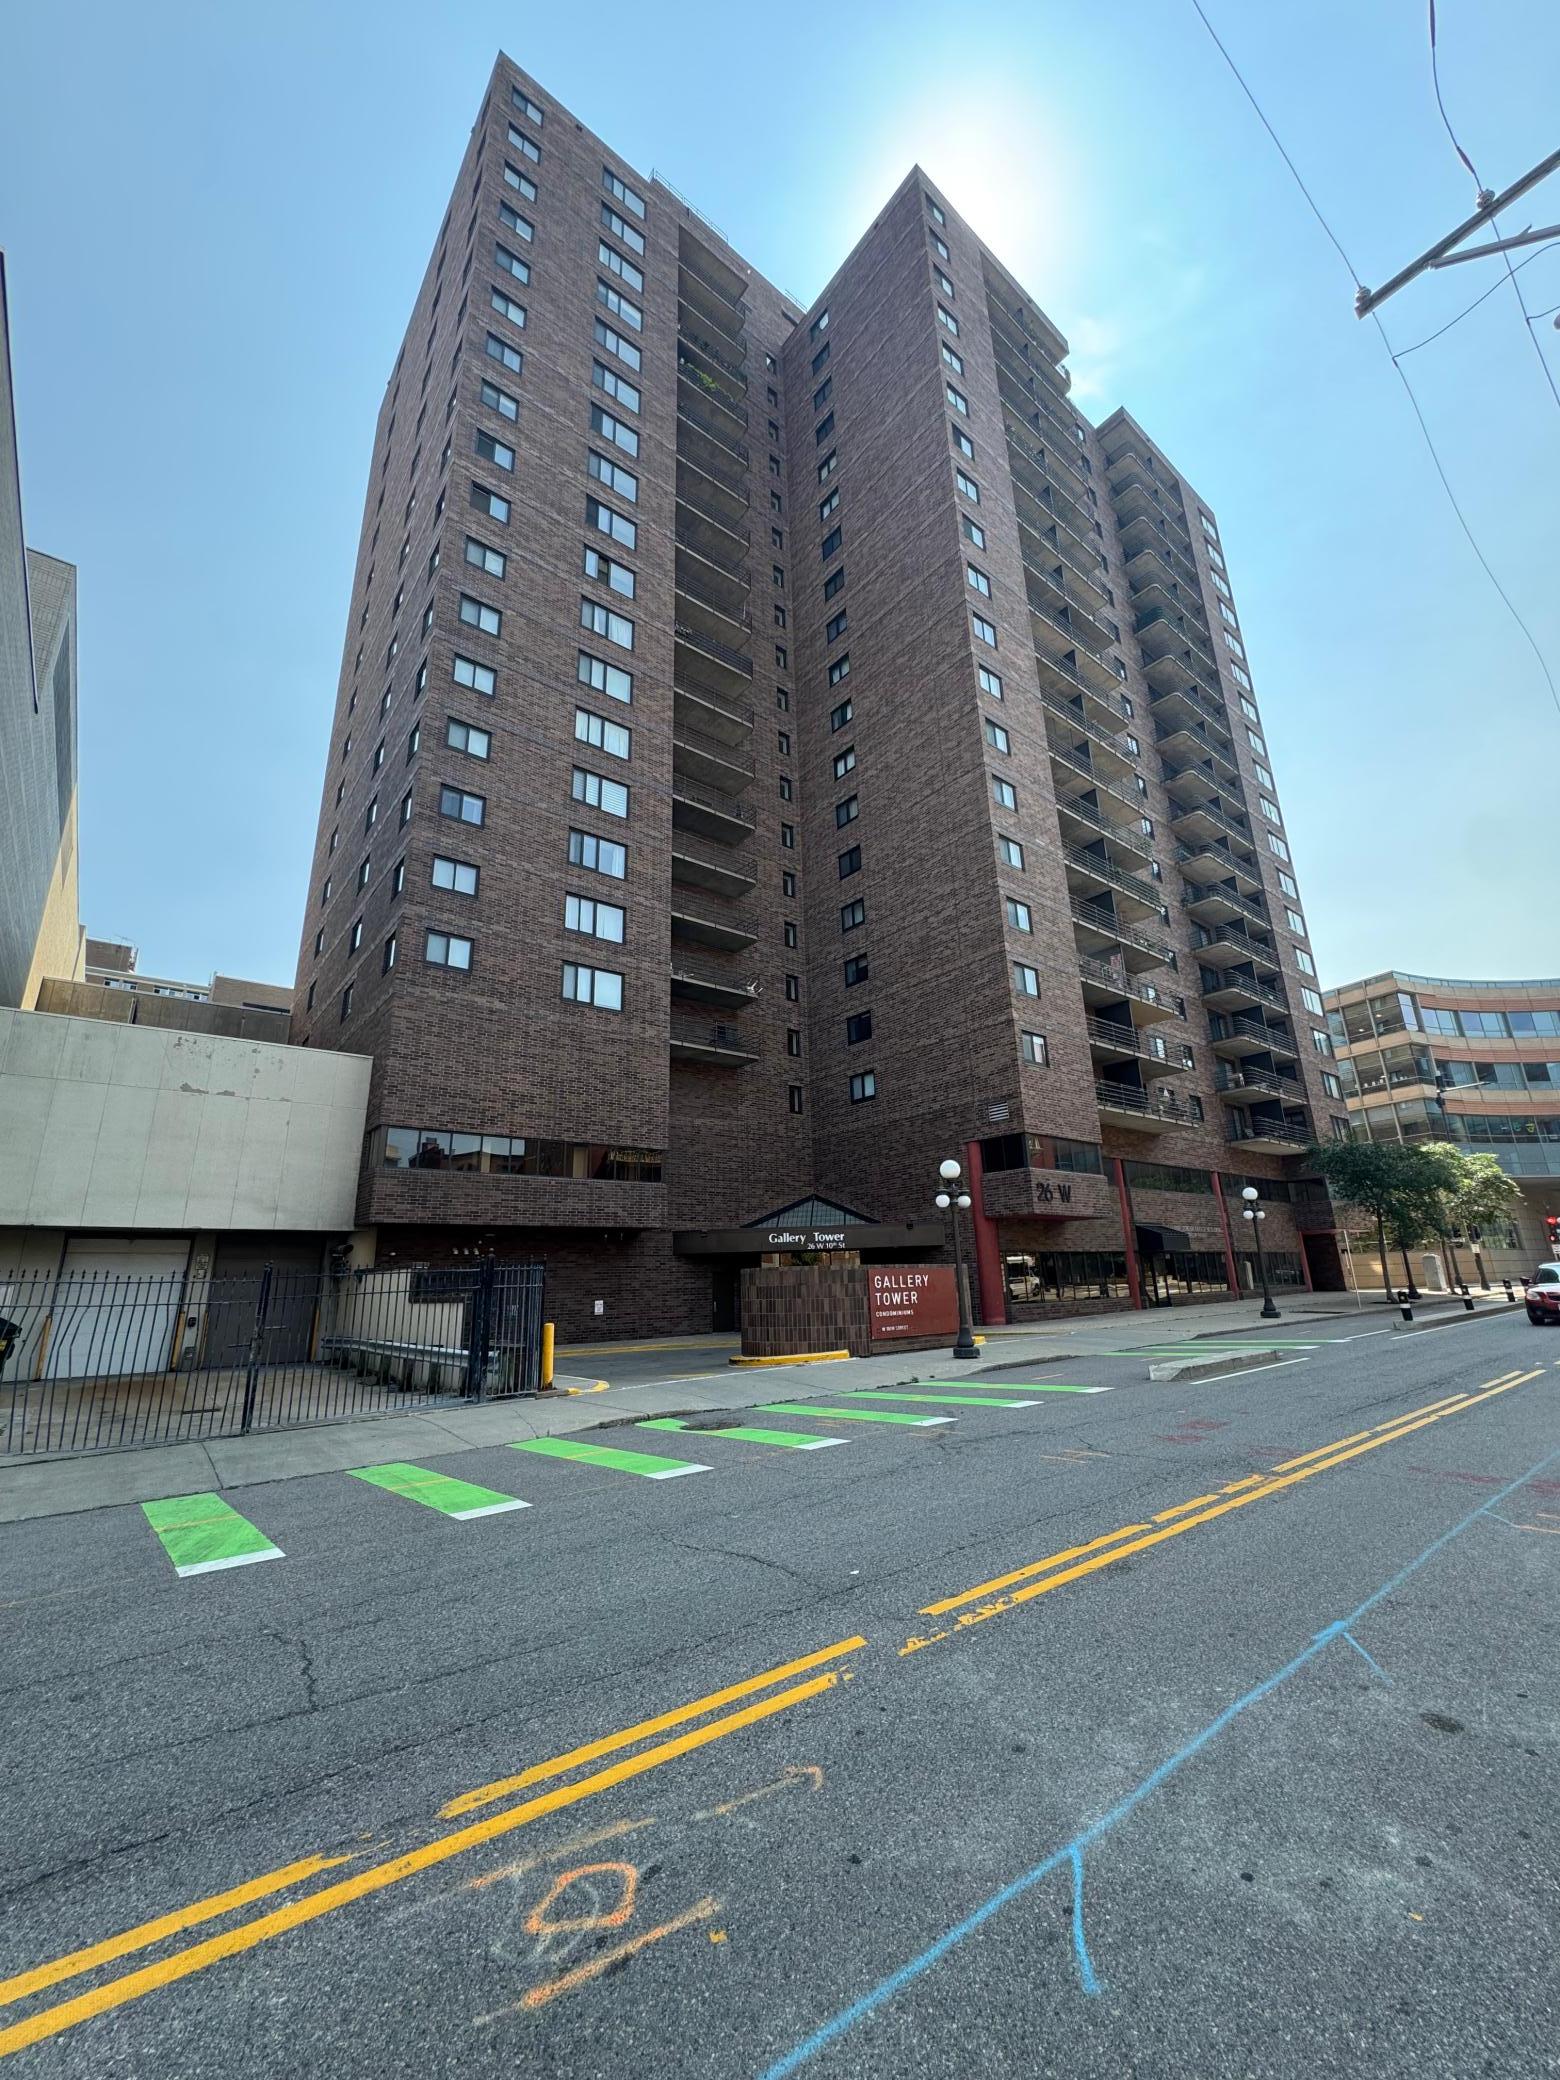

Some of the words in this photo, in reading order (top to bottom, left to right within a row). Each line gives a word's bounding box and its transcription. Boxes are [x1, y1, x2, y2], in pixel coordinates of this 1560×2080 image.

[1036, 1182, 1053, 1202] 26
[1057, 1183, 1071, 1203] W
[768, 1232, 806, 1245] Gallery
[813, 1231, 845, 1242] Tower
[874, 1274, 929, 1288] GALLERY
[875, 1291, 918, 1306] TOWER
[875, 1309, 914, 1318] CONDOMINIUMS
